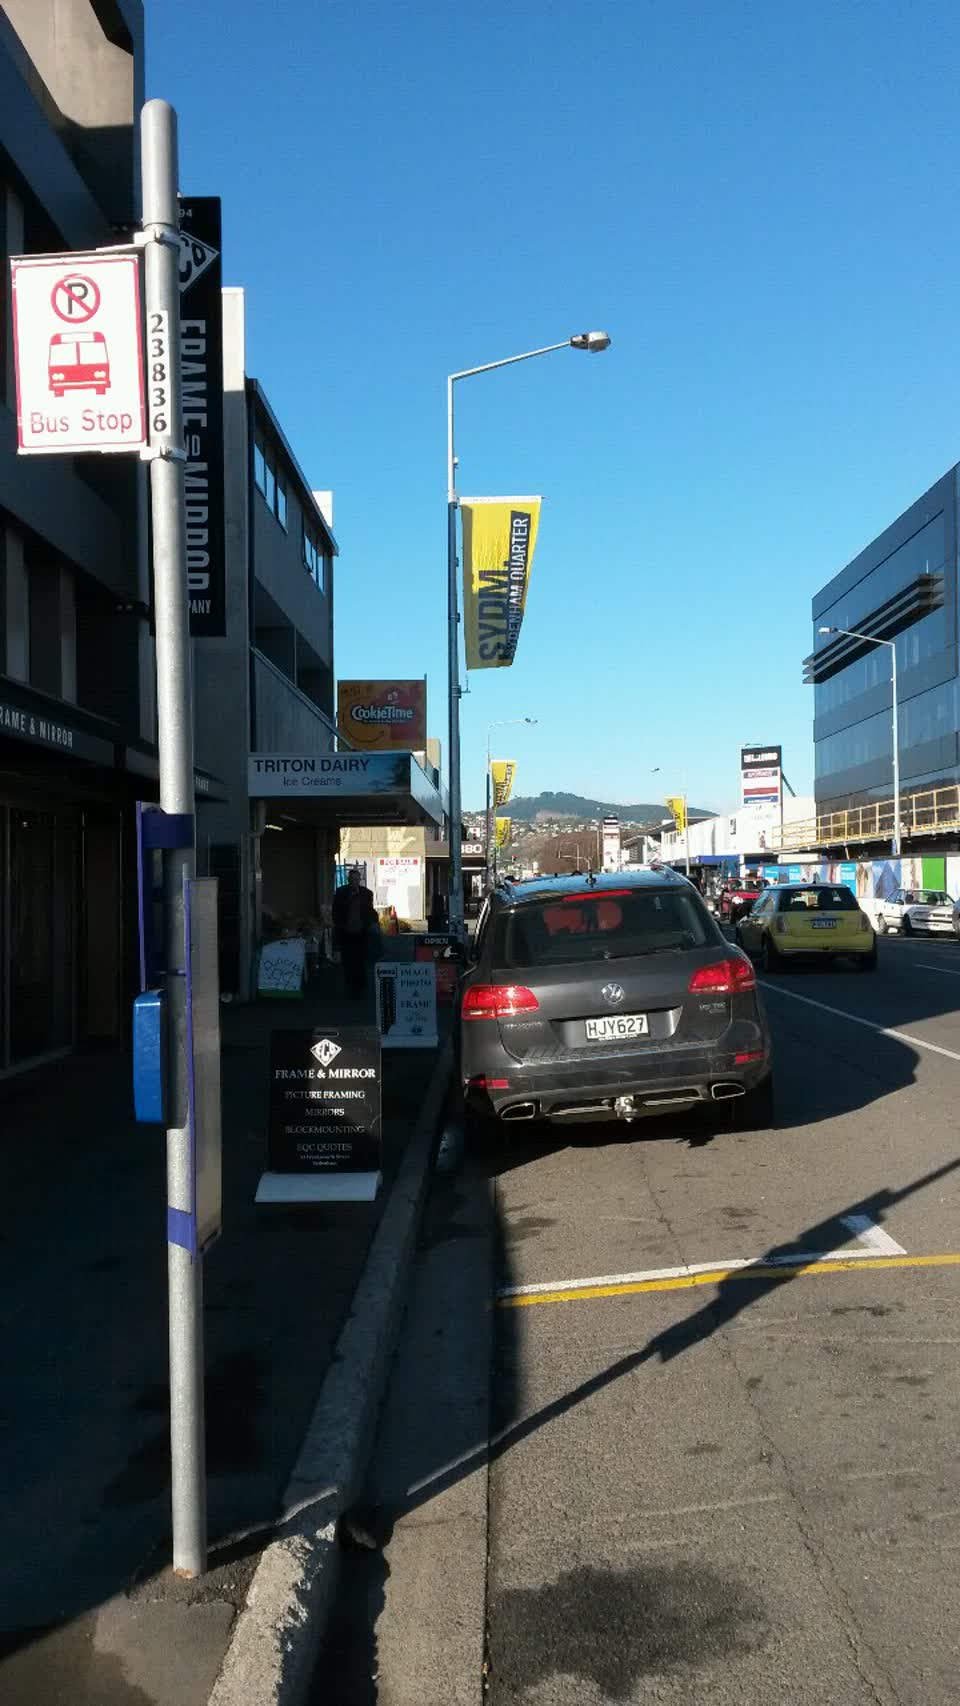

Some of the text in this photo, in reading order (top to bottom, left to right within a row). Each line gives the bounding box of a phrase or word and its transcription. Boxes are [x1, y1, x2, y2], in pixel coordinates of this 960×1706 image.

[151, 313, 168, 433] 23836
[31, 409, 133, 434] Bus Stop
[509, 517, 529, 582] QUARTER
[30, 717, 36, 735] &
[40, 721, 73, 748] MIRROR
[254, 759, 371, 773] TRITON DAIRY
[283, 776, 343, 787] Ice Creams
[400, 968, 430, 977] IMAGE
[400, 1000, 432, 1009] FRAME
[587, 1015, 646, 1037] HJY627
[275, 1068, 376, 1079] FRAME & MIRROR
[284, 1090, 366, 1099] PICTURE FRAMING
[304, 1108, 345, 1117] MIRRORS
[285, 1125, 366, 1135] BLOCKMOUNTING
[316, 1143, 353, 1152] QUOTES
